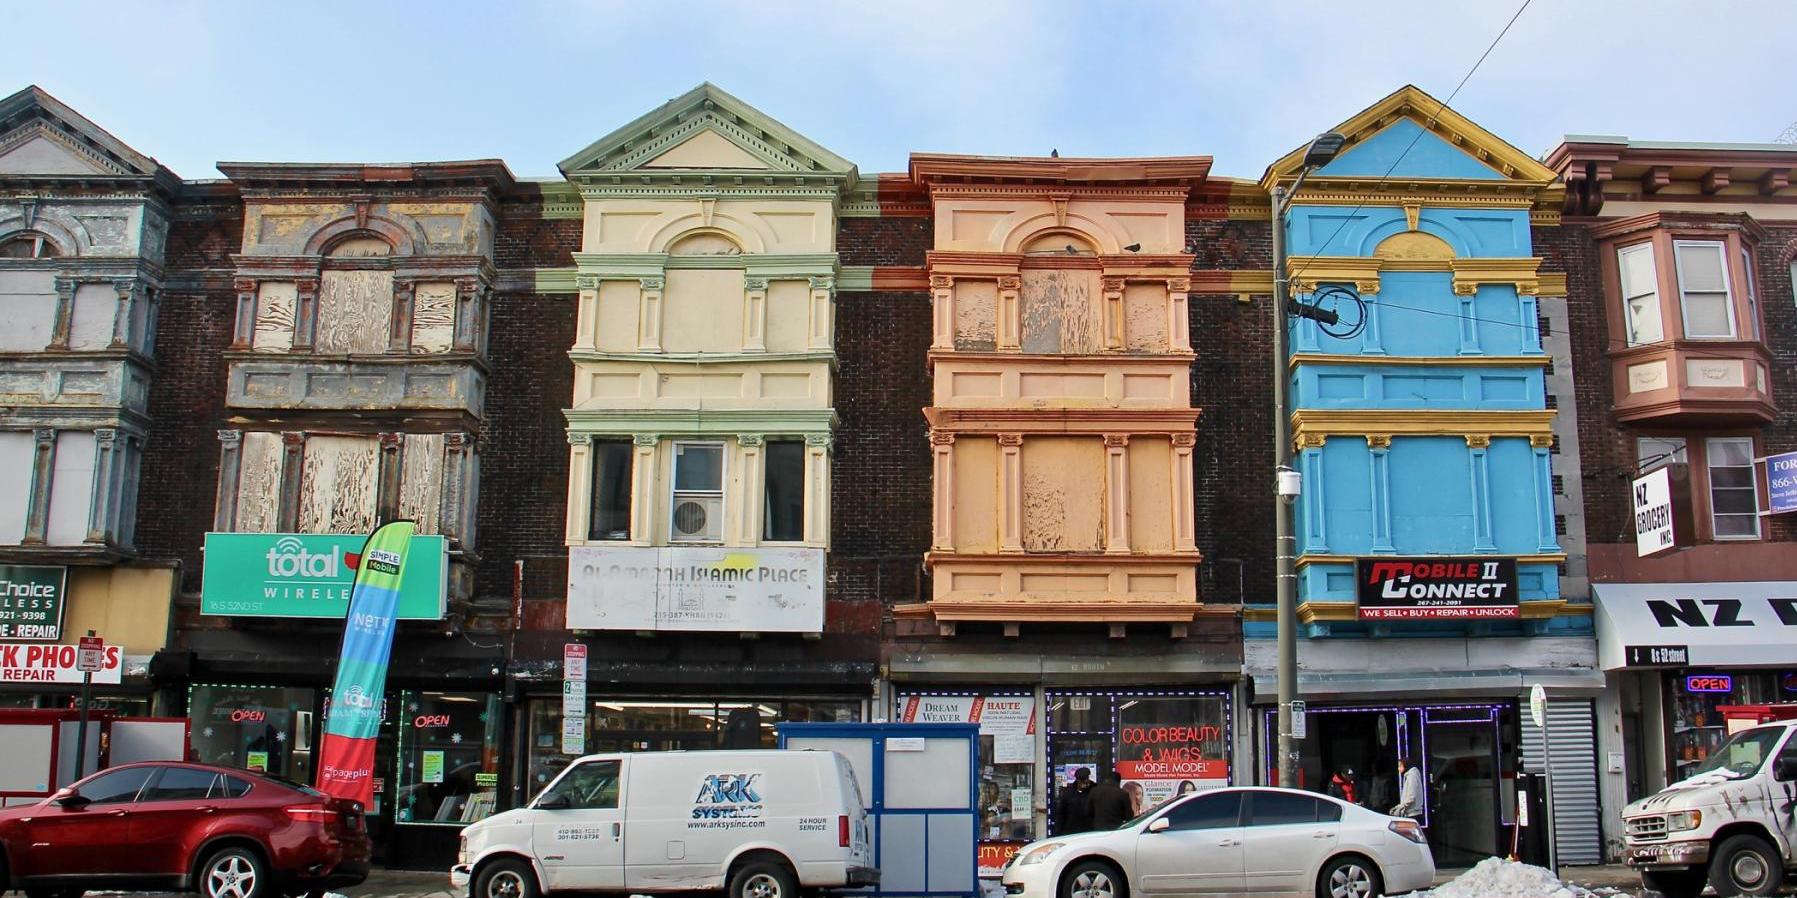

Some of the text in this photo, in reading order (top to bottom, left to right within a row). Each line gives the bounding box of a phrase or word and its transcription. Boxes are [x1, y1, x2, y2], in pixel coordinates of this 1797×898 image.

[1636, 483, 1648, 508] NZ
[1636, 503, 1670, 535] GROCERY
[266, 545, 339, 577] total
[370, 551, 399, 563] SIMPLE
[369, 561, 397, 573] Mobile
[1369, 562, 1499, 584] MOBILE II
[1381, 574, 1507, 599] CONNECT
[264, 587, 349, 599] WIRELE
[1364, 609, 1515, 617] WE SELL BUY REPAIR UNLOCK
[1645, 599, 1755, 628] NZ
[17, 625, 57, 638] REPAIR
[0, 646, 19, 668] K
[4, 669, 55, 681] REPAIR
[1690, 678, 1729, 689] OPEN
[925, 703, 958, 712] DREAM
[987, 702, 1021, 710] HAUTE
[232, 710, 265, 722] OPEN
[415, 715, 450, 728] OPEN
[923, 712, 960, 722] WEAVER
[1122, 726, 1220, 743] COLOR BEAUTY
[1143, 747, 1202, 761] & WIGS
[1135, 762, 1208, 773] MODEL MODEL
[695, 774, 762, 803] ARK
[687, 820, 765, 830] www.arksysinc.com
